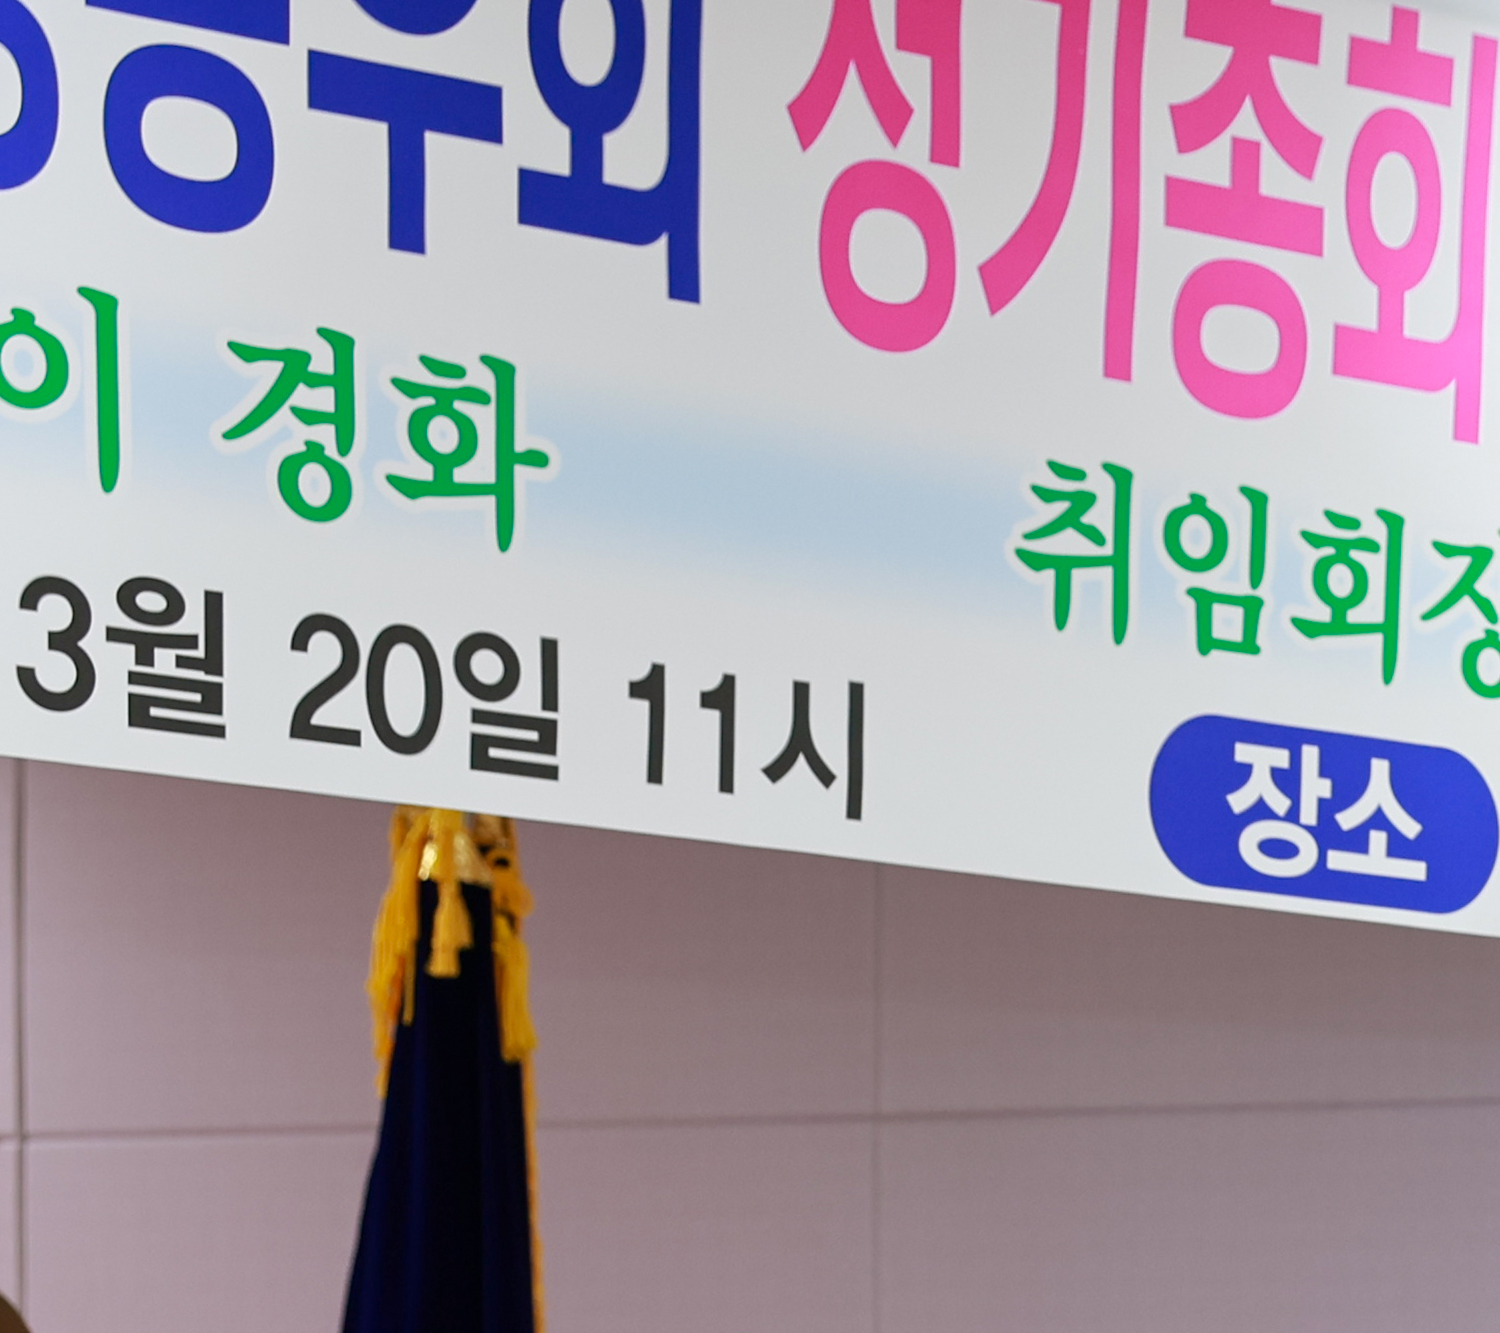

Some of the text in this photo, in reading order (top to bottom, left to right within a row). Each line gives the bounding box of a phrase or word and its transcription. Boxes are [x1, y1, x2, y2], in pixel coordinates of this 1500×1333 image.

[786, 0, 1499, 446] 정기총회
[221, 327, 550, 553] 경화
[15, 575, 865, 821] 3월 20일 11시
[1225, 741, 1429, 882] 장소
